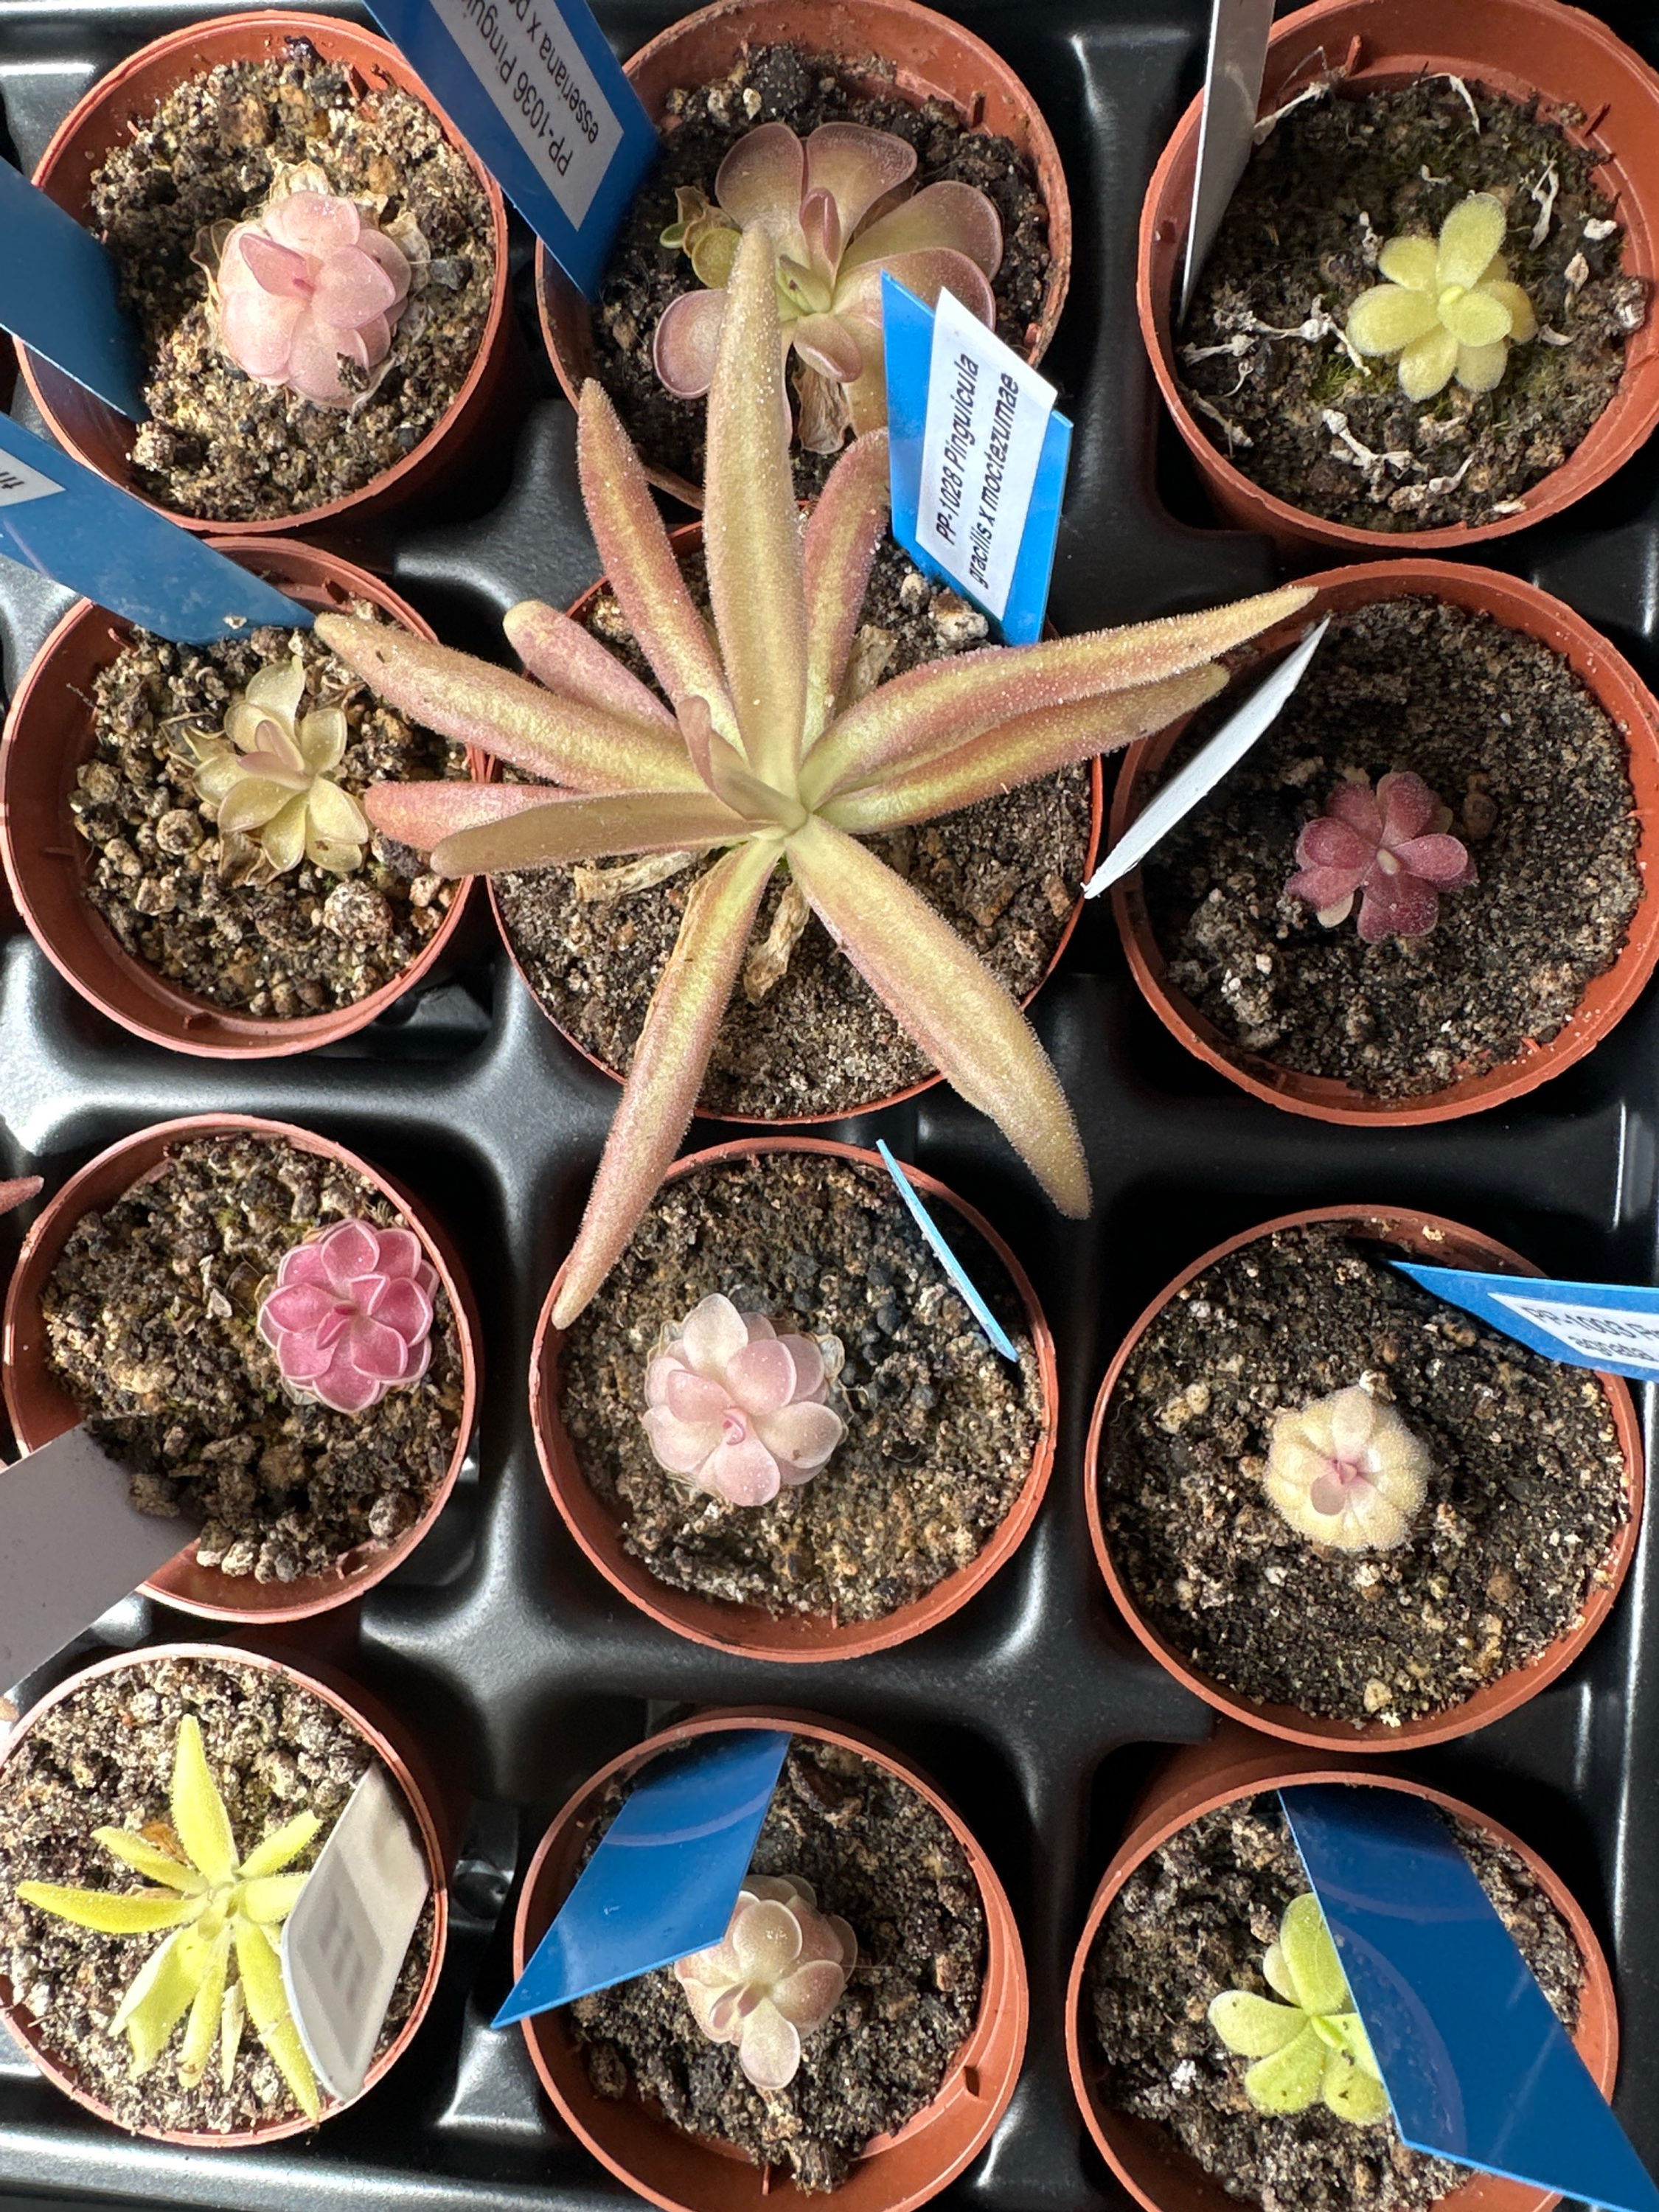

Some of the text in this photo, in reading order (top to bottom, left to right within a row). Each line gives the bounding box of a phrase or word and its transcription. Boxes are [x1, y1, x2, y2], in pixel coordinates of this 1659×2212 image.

[461, 0, 573, 176] PP-1036 Pingui
[526, 11, 542, 43] x
[540, 31, 599, 144] esseriana
[936, 353, 978, 546] PP-1028 Pinguicula
[968, 373, 1019, 589] gracilis x moctezumae
